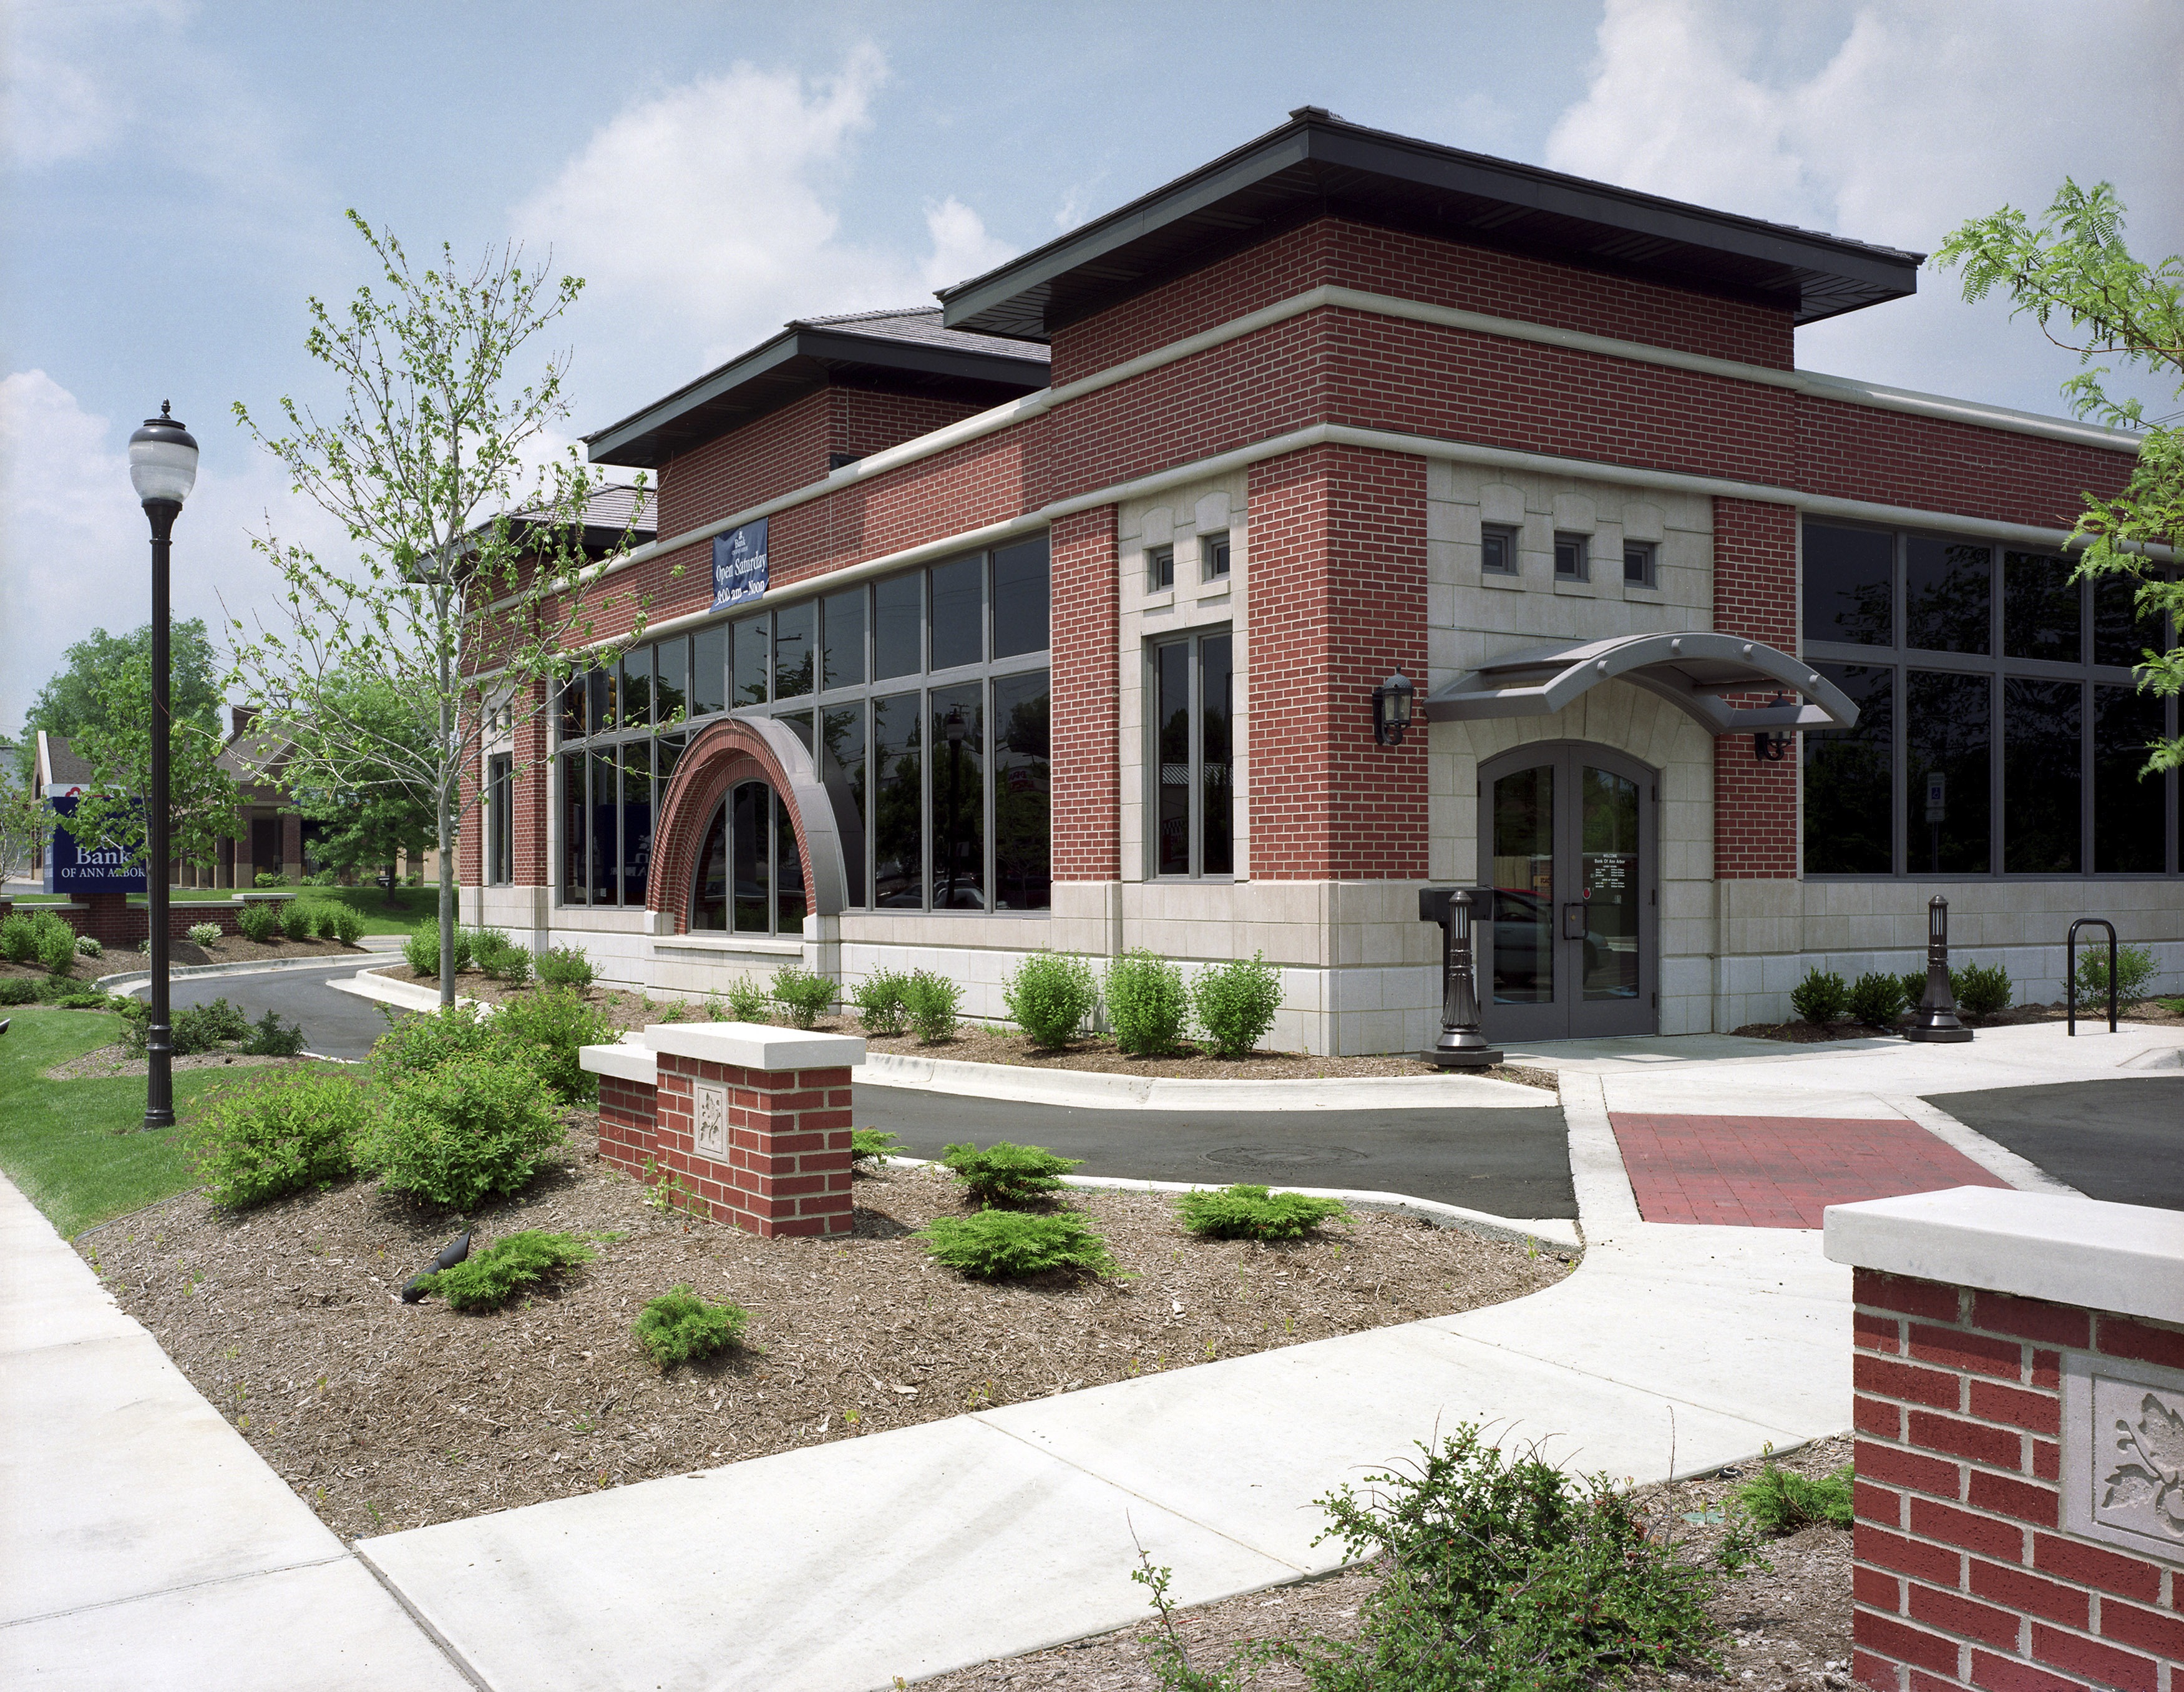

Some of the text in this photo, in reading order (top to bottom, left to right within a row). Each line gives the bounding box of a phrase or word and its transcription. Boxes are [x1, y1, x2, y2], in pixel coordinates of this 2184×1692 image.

[716, 565, 733, 585] Open
[734, 550, 767, 575] Saturday
[714, 587, 731, 607] 9:00
[731, 587, 742, 600] am
[748, 580, 765, 595] Noon
[76, 845, 132, 864] Bank
[61, 868, 76, 878] OF
[79, 868, 104, 877] ANN
